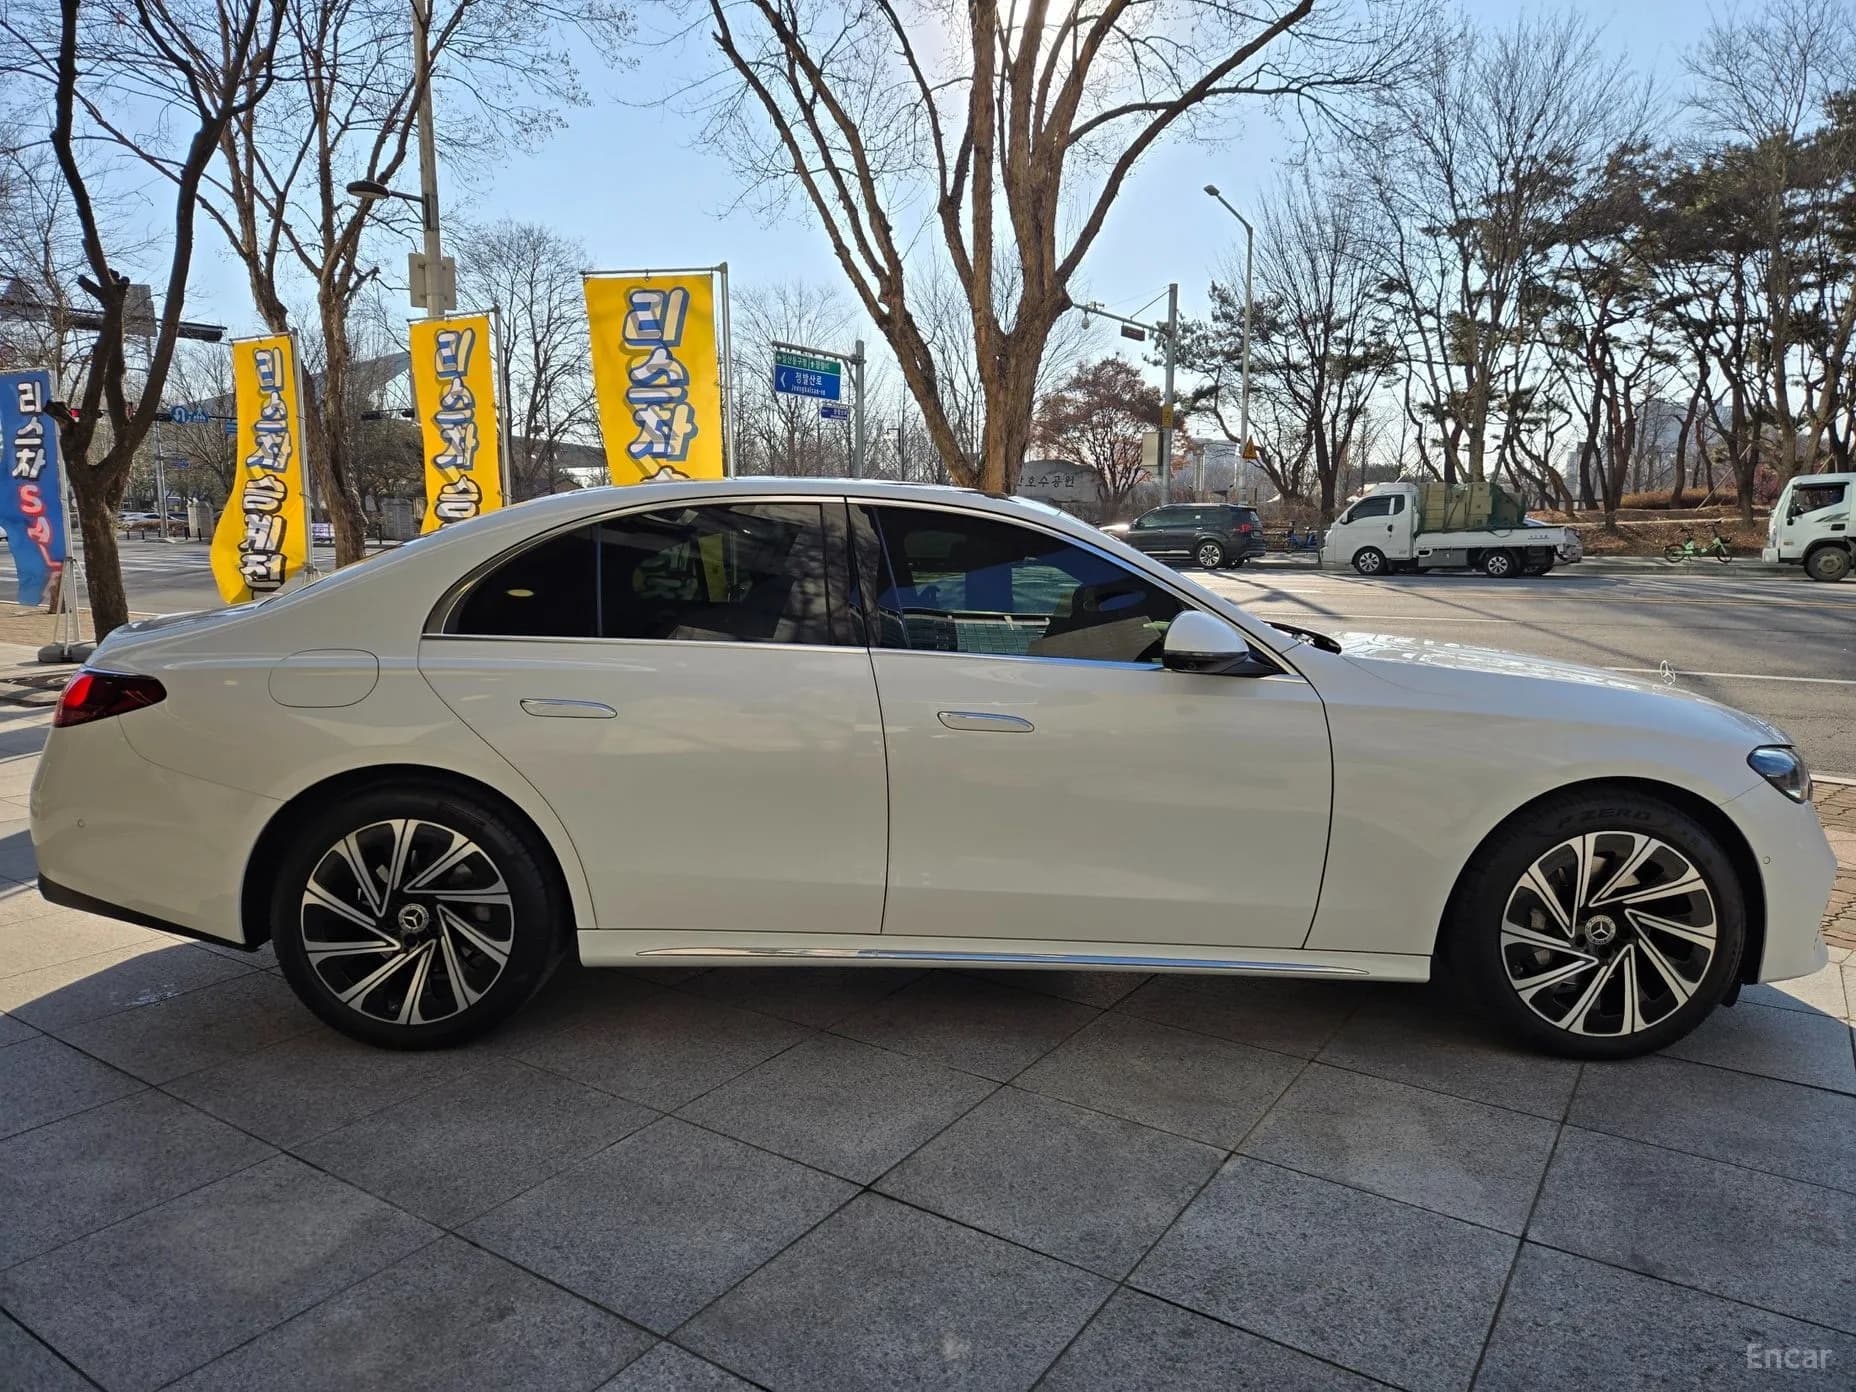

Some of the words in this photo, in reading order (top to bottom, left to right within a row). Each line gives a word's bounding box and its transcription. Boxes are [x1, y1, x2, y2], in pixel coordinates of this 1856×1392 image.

[11, 380, 47, 480] 리스차
[246, 347, 292, 474] 리스차
[432, 327, 479, 471] 리스차
[622, 286, 698, 461] 리스차
[795, 371, 822, 386] 정발산로
